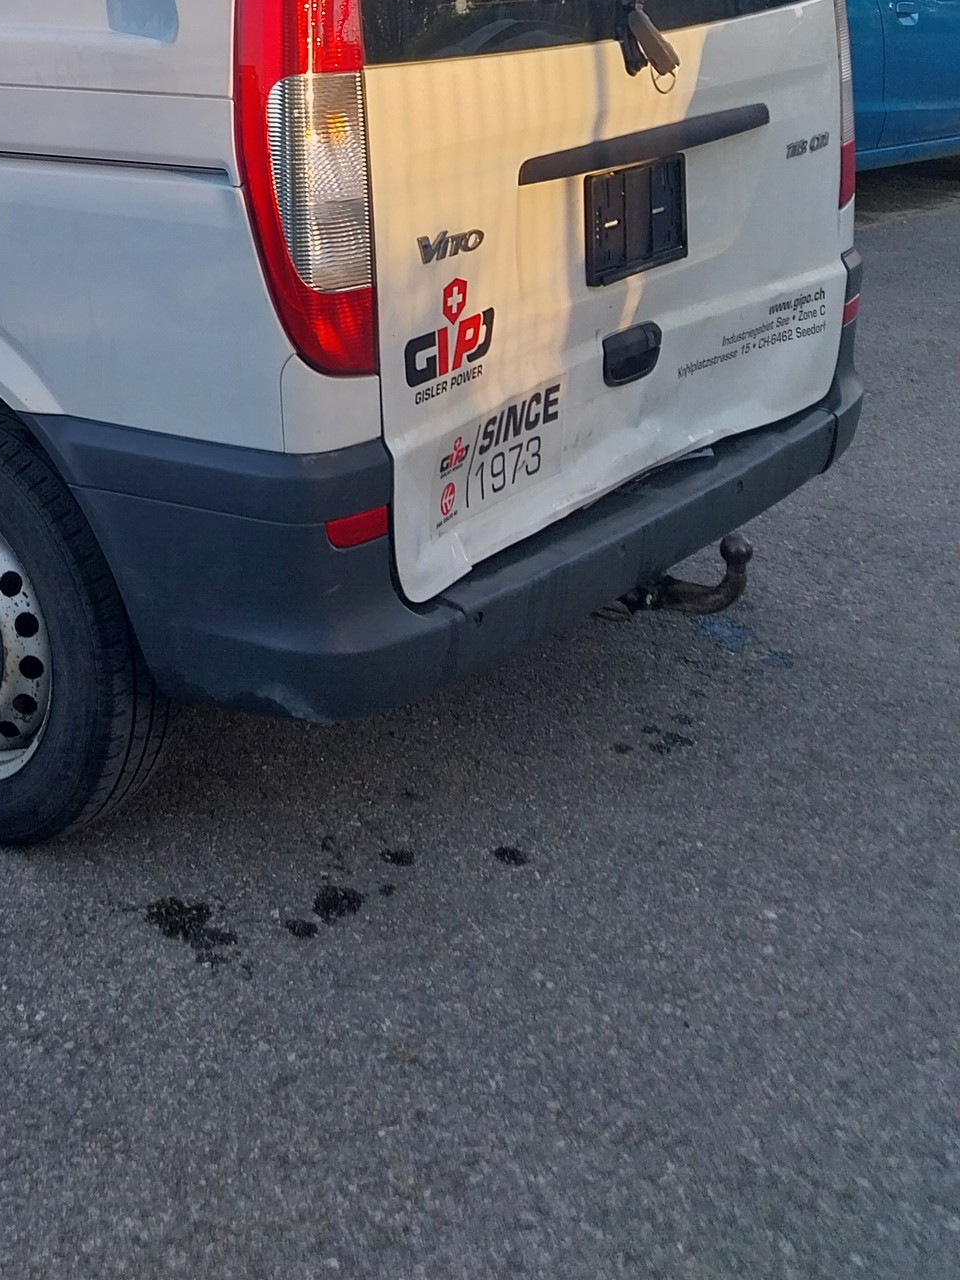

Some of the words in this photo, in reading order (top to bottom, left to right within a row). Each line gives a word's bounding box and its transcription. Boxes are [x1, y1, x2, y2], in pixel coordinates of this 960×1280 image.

[768, 287, 825, 315] www.gipo.ch
[721, 320, 774, 347] Industriegebiet
[776, 315, 790, 329] See
[798, 307, 818, 322] Zone
[819, 304, 827, 316] C
[740, 342, 751, 356] 15
[758, 328, 793, 350] CH-6462
[795, 320, 827, 339] Seedorf
[415, 381, 447, 406] GISLER
[451, 364, 483, 391] POWER
[479, 384, 561, 455] SINCE
[475, 435, 542, 501] 1973
